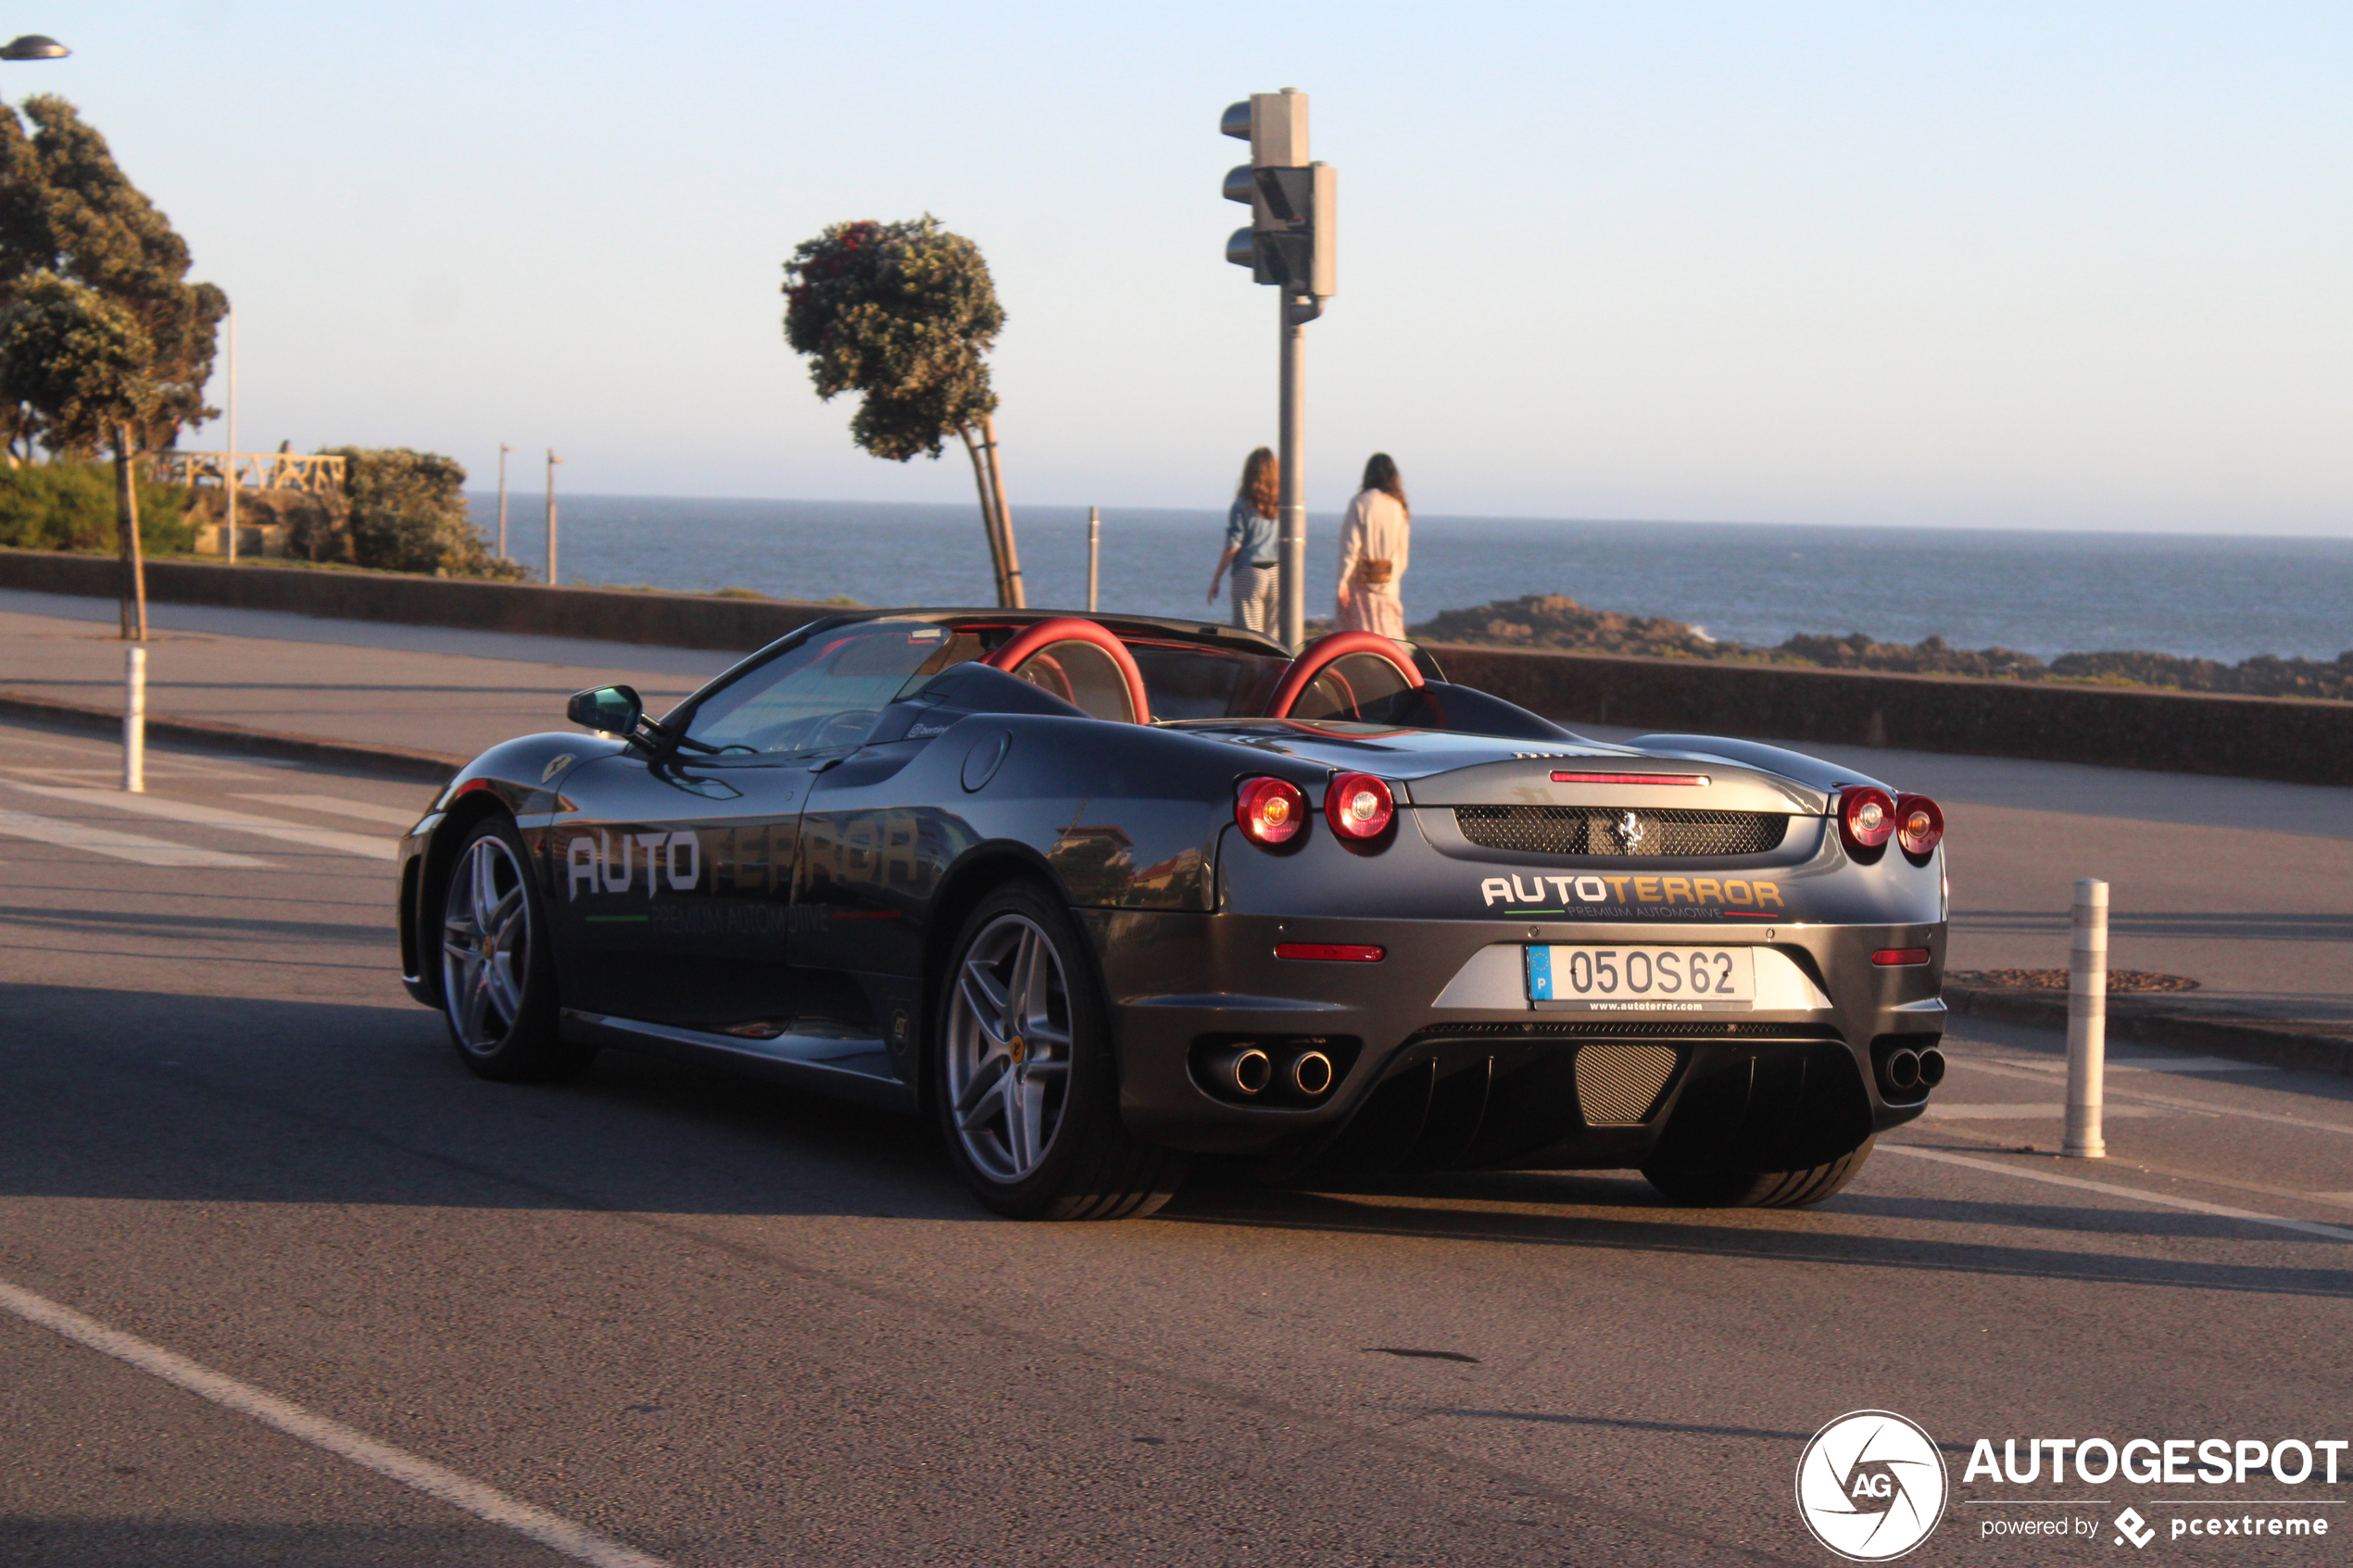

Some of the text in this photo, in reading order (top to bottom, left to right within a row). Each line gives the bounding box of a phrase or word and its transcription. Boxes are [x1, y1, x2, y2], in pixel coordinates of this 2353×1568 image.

[566, 818, 920, 904] AUTOTERROR
[1480, 873, 1785, 909] AUTOTERROR
[650, 903, 829, 934] PREMIUM AUTOMOTIVE
[1567, 907, 1723, 919] PREMIUM AUTOMOTIVE
[1537, 978, 1546, 990] P
[1590, 1002, 1703, 1011] www.autoterror.com
